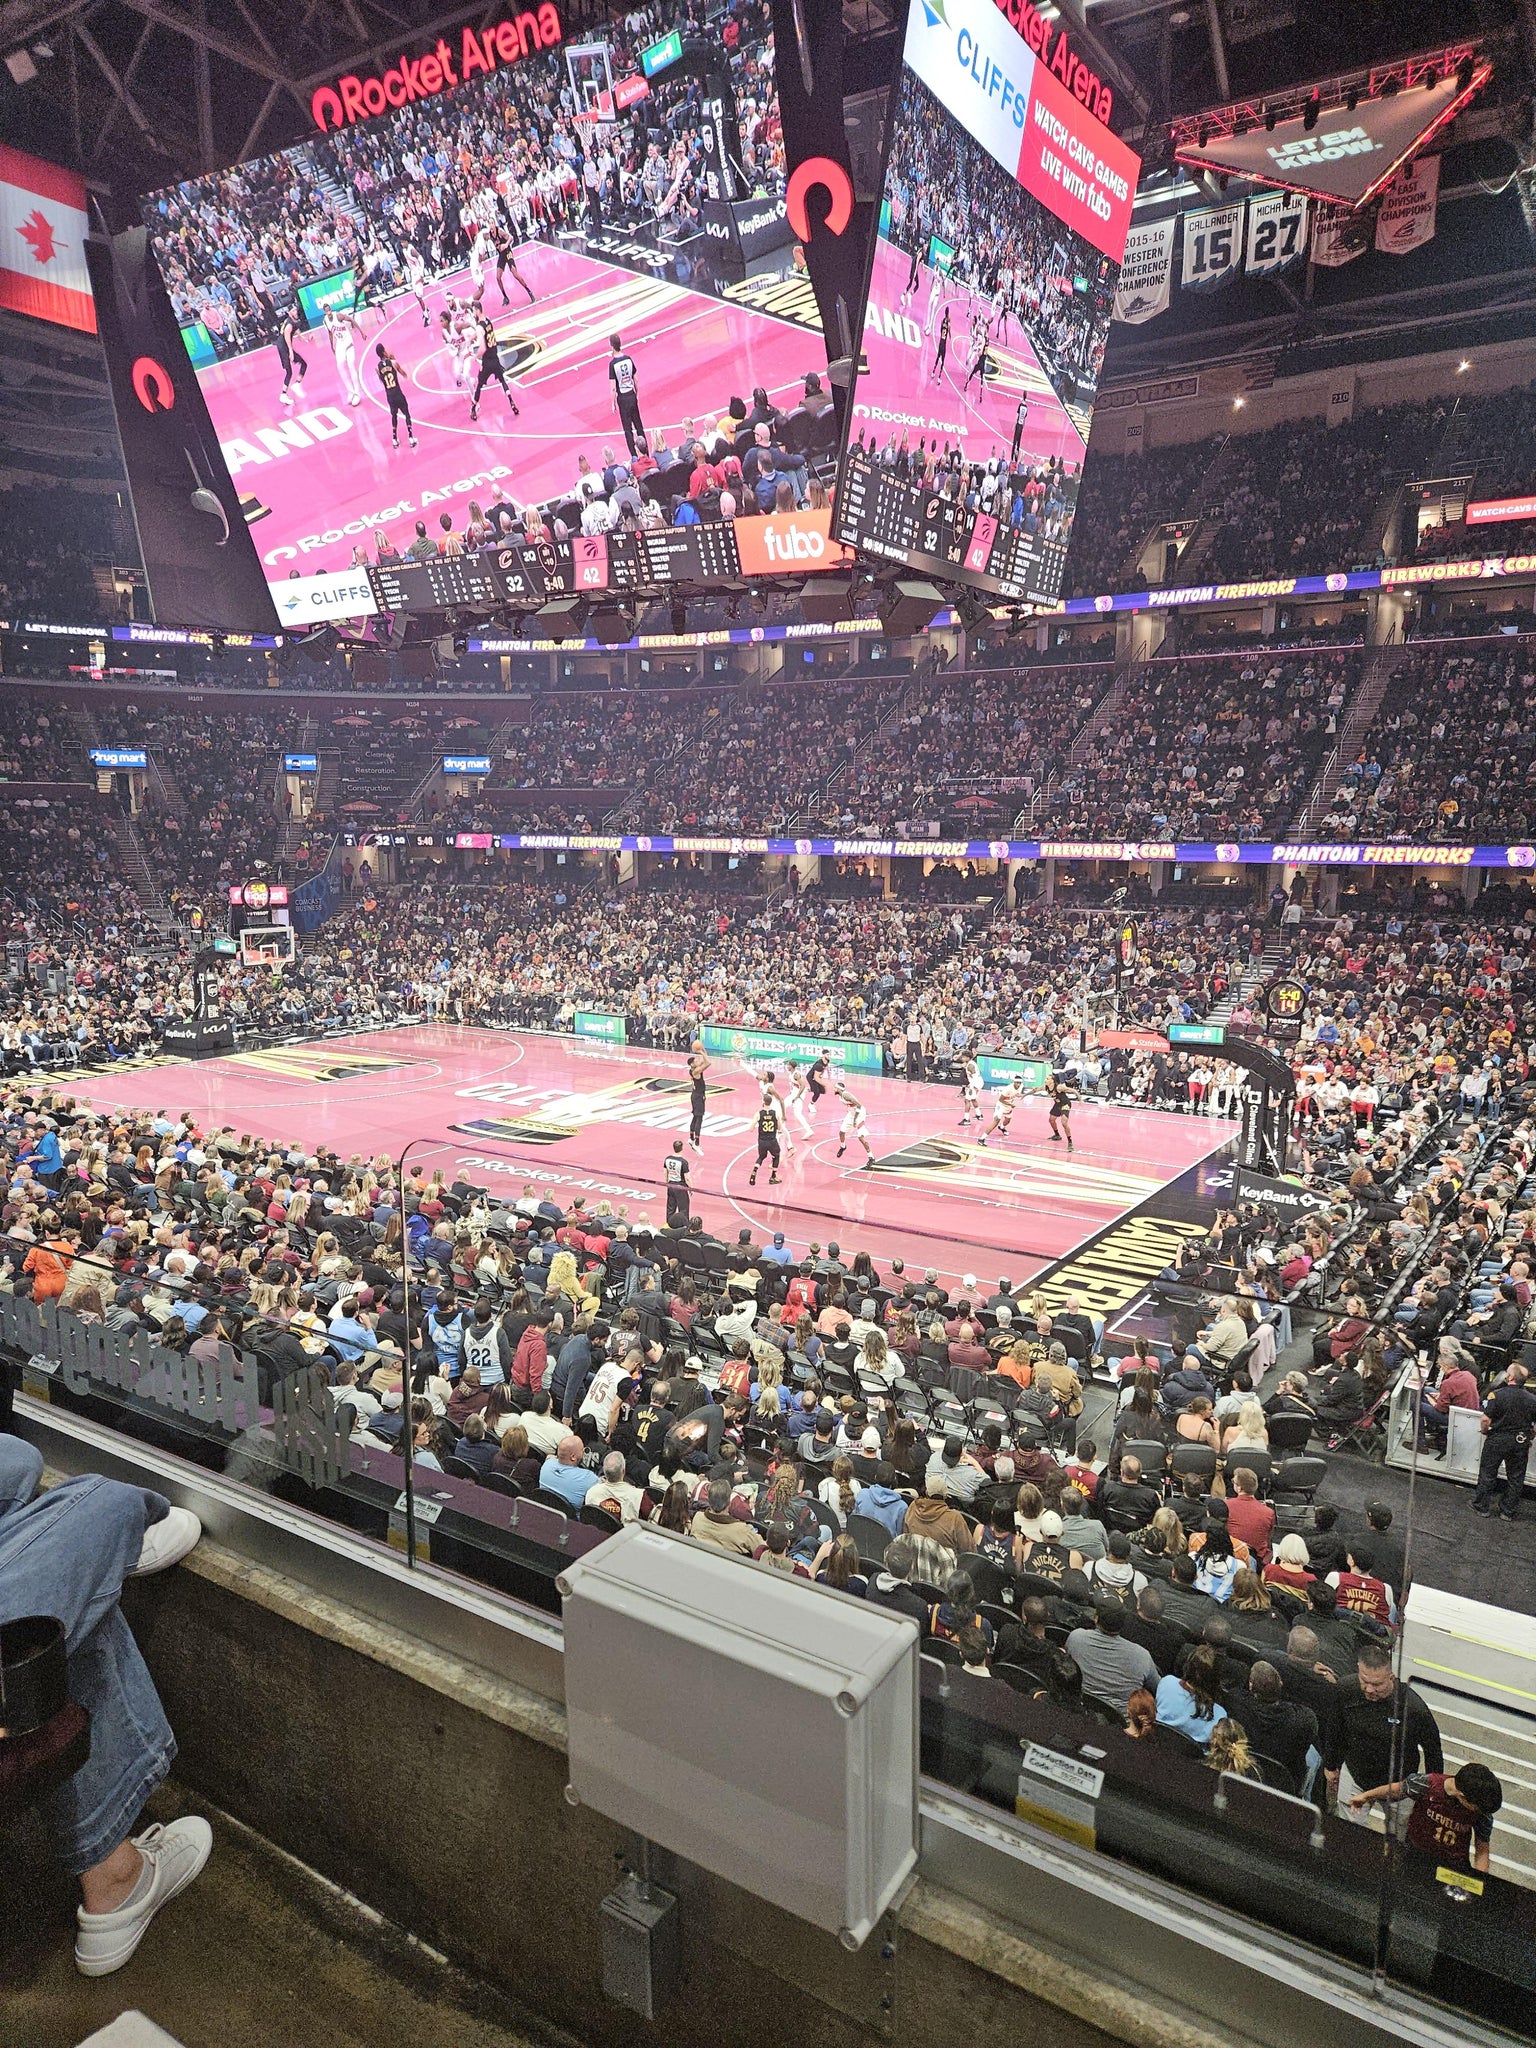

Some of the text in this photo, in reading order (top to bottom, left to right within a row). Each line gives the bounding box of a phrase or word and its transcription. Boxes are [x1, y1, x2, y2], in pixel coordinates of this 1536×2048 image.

[342, 2, 561, 117] Rocket Arena
[957, 27, 1026, 129] CLIFFS
[1051, 31, 1113, 125] Arena
[1034, 100, 1128, 201] WATCH CAVS GAMES
[1266, 127, 1367, 160] LET EM
[715, 118, 734, 196] Cleveland Clinic
[1275, 139, 1385, 169] KNOW.
[1041, 147, 1111, 221] LIVE WITH fubo
[1388, 192, 1426, 208] DIVISION
[1189, 212, 1238, 232] CALLANDER
[1382, 205, 1432, 222] CHAMPIONS
[738, 210, 777, 237] KeyBank
[1126, 230, 1164, 248] 2015-16
[1254, 214, 1301, 262] 27
[587, 236, 675, 267] CLIFFS
[1124, 247, 1163, 264] WESTERN
[1192, 228, 1232, 274] 15
[1118, 274, 1165, 292] CHAMPIONS
[384, 374, 397, 389] 12
[1333, 392, 1348, 402] 210
[870, 405, 968, 436] Rocket Arena
[294, 466, 513, 553] Rocket Arena
[1472, 506, 1530, 518] WATCH CAVS
[967, 515, 974, 529] 14
[764, 525, 824, 562] fubo
[924, 530, 937, 550] 32
[558, 544, 569, 557] 14
[972, 549, 983, 567] 42
[584, 568, 600, 583] 42
[1382, 563, 1481, 583] FIREWORKS
[506, 575, 524, 592] 32
[544, 576, 564, 591] 5:40
[1149, 578, 1296, 605] PHANTOM FIREWORKS
[311, 584, 371, 606] CLIFFS
[25, 624, 48, 632] LET
[49, 625, 68, 634] EM
[130, 628, 186, 642] PHANTOM
[786, 623, 832, 637] PHANTOM
[482, 641, 529, 650] PHANTOM
[640, 632, 729, 646] FIREWORKS COM
[120, 752, 147, 763] mart
[444, 758, 490, 770] drug mart
[376, 836, 390, 846] 32
[418, 837, 433, 846] 5:40
[460, 837, 472, 846] 42
[520, 836, 622, 848] PHANTOM FIREWORKS
[674, 838, 768, 850] FIREWORKS COM
[834, 841, 968, 856] PHANTOM FIREWORKS
[1042, 844, 1174, 858] FIREWORKS COM
[1272, 846, 1474, 864] PHANTOM FIREWORKS
[1280, 990, 1300, 1000] 5:40
[1280, 1000, 1295, 1012] 14
[166, 1030, 186, 1038] KeyBank
[748, 1038, 784, 1052] TREES
[762, 1121, 774, 1132] 32
[1246, 1104, 1259, 1165] Cleveland Clinic
[668, 1161, 676, 1170] 52
[480, 1160, 656, 1202] Rocket Arena
[1240, 1186, 1298, 1206] KeyBank
[618, 1340, 628, 1356] 2
[471, 1348, 491, 1366] 22
[723, 1369, 744, 1388] 31
[590, 1382, 610, 1404] 45
[637, 1421, 650, 1442] 4
[1032, 1554, 1066, 1572] MITCHELL
[1346, 1588, 1380, 1605] MITCHELL
[1031, 1748, 1096, 1780] Production Date
